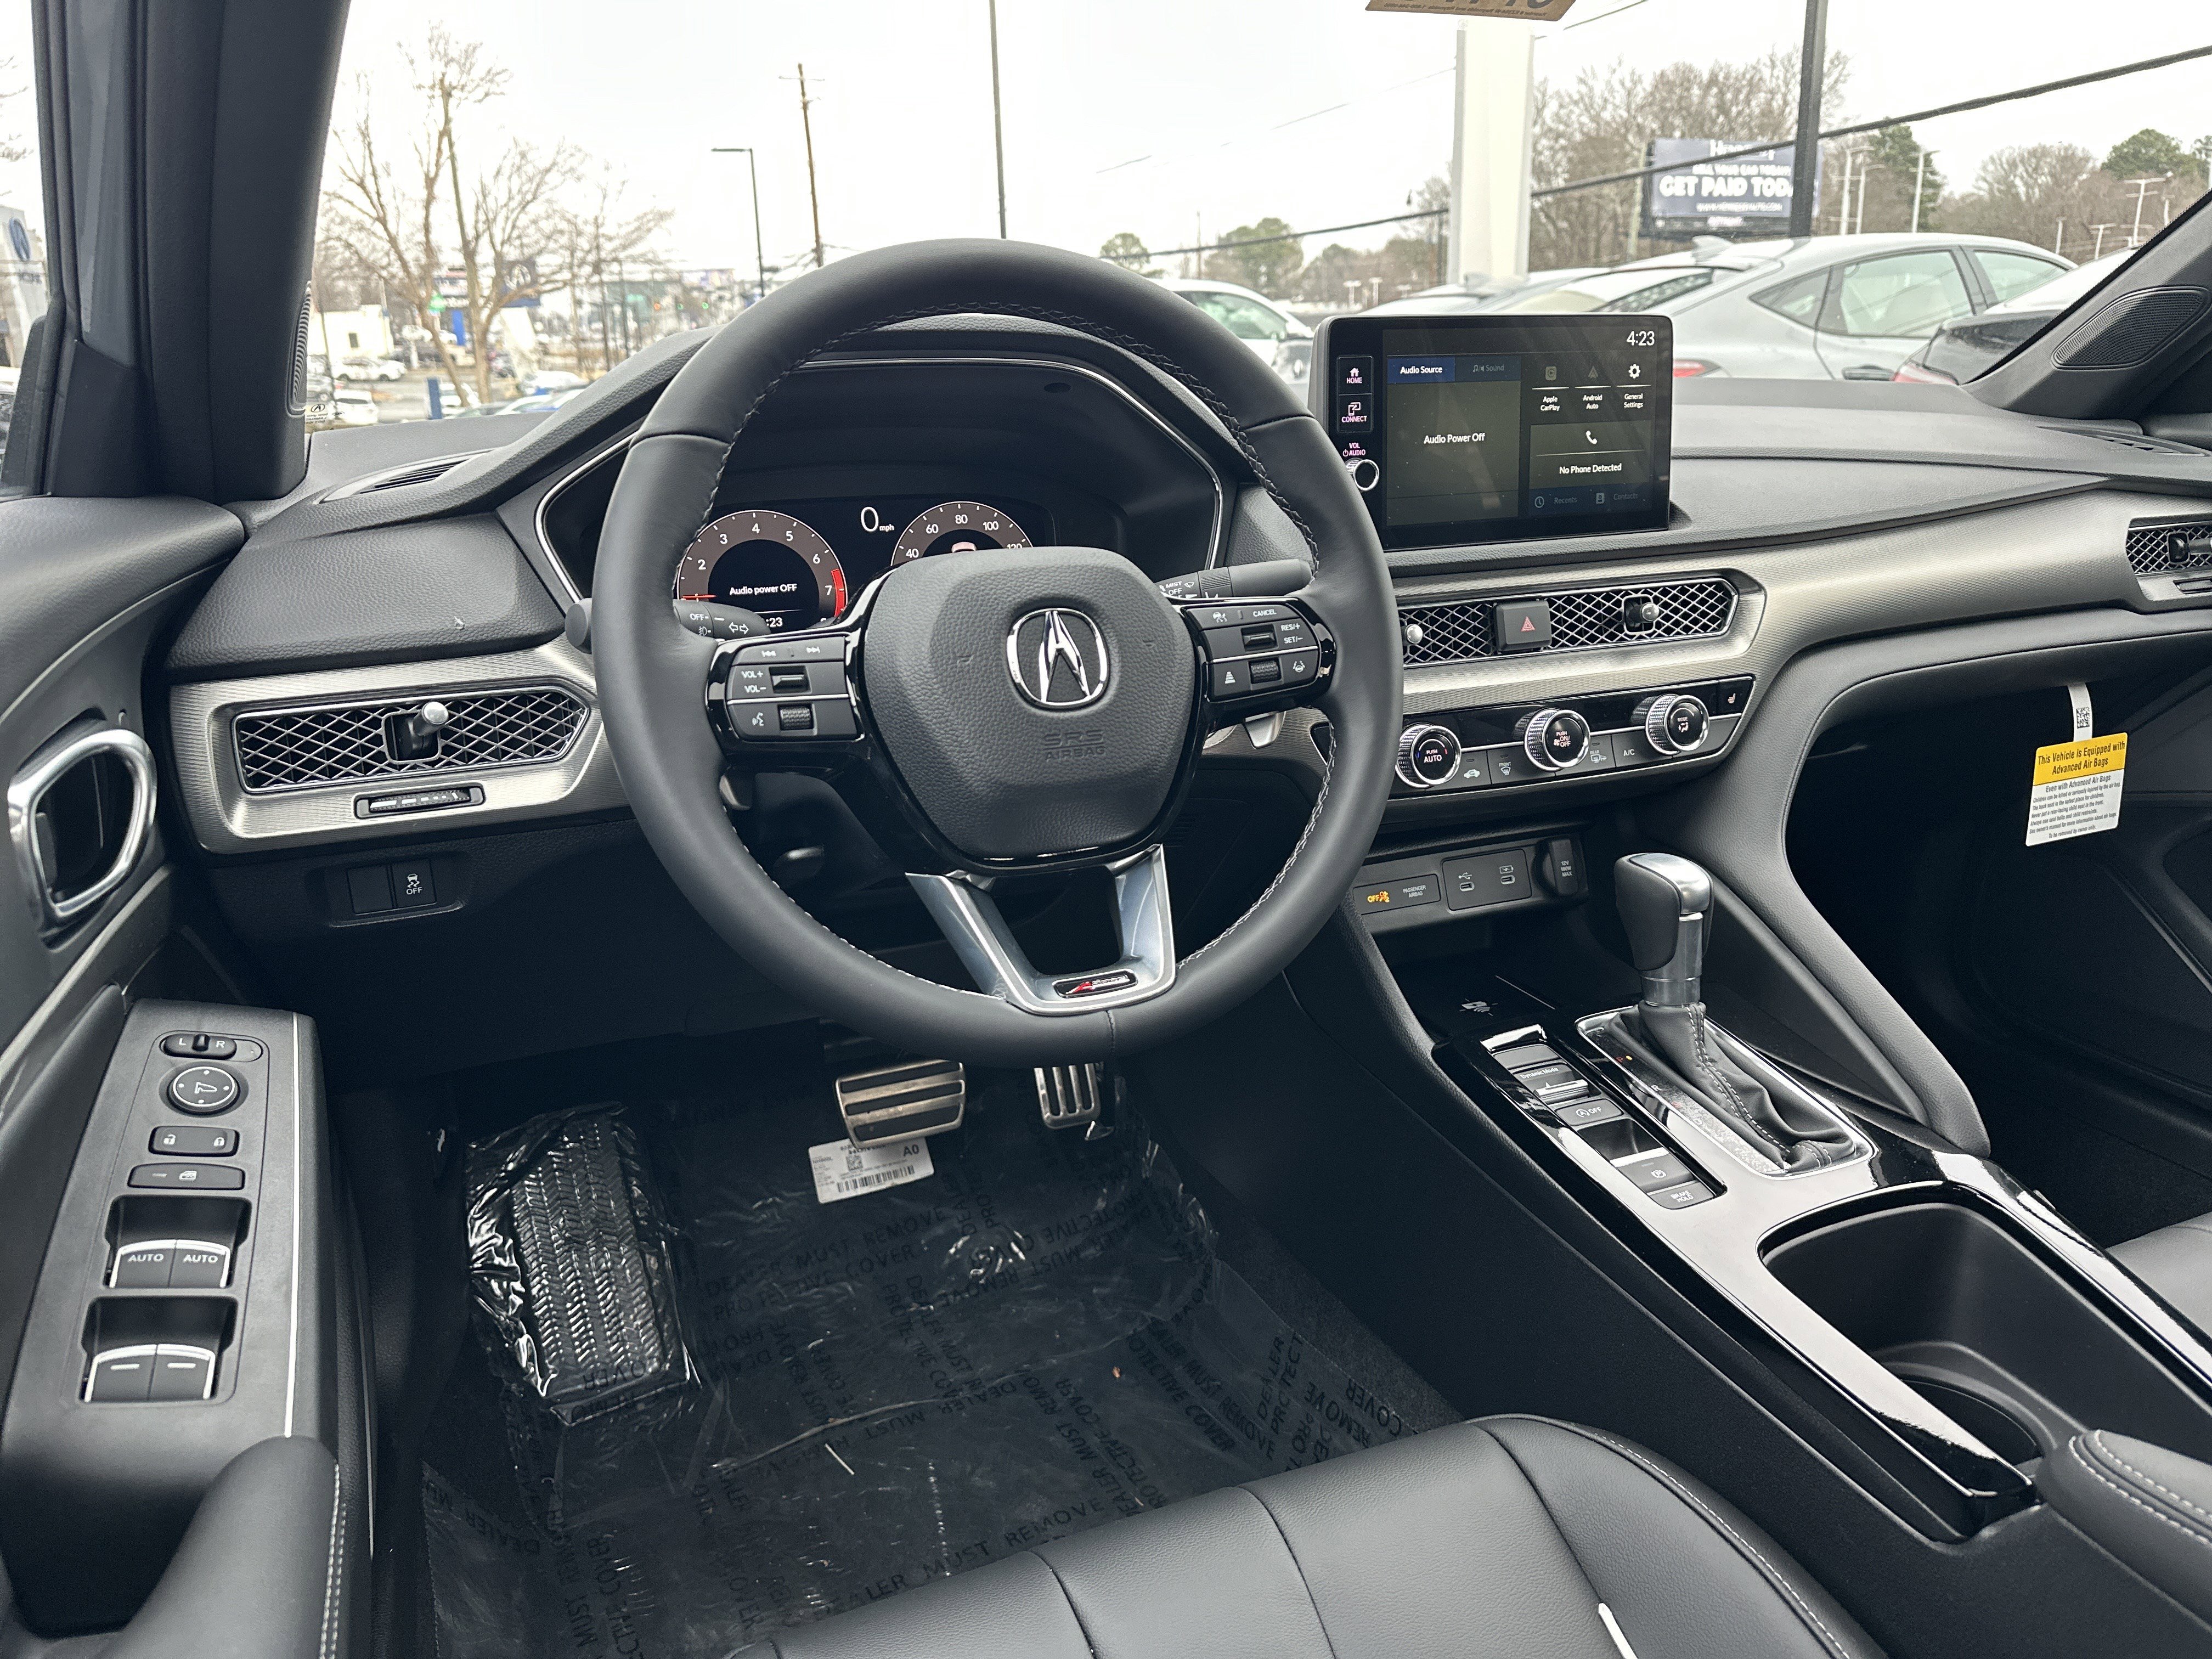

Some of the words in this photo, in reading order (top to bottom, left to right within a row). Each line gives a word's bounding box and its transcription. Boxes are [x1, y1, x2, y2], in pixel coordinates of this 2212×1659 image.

[1660, 175, 1699, 196] GET
[1701, 177, 1748, 197] PAID
[1626, 331, 1655, 346] 4:23
[1400, 366, 1418, 374] Audio
[1419, 365, 1443, 374] Source
[1486, 363, 1504, 373] Sound
[1543, 396, 1558, 404] Apple
[1540, 403, 1560, 412] CarPlay
[1623, 402, 1644, 410] Settings
[1341, 415, 1368, 423] CONNECT
[1424, 434, 1445, 444] Audio
[1447, 433, 1470, 444] Power
[1472, 432, 1485, 442] Off
[1559, 465, 1568, 473] No
[1570, 465, 1590, 473] Phone
[1592, 462, 1622, 472] Detected
[1554, 496, 1577, 505] Recents
[955, 514, 968, 524] 80
[752, 523, 760, 534] 4
[879, 523, 894, 533] mph
[926, 524, 939, 534] 60
[983, 521, 999, 531] 100
[719, 533, 728, 544] 3
[786, 531, 793, 541] 5
[906, 548, 919, 558] 40
[697, 559, 707, 570] 2
[812, 554, 821, 565] 6
[729, 585, 753, 595] Audio
[754, 585, 778, 595] power
[780, 583, 797, 592] OFF
[825, 585, 832, 596] 7
[1253, 609, 1277, 617] CANCEL
[765, 617, 783, 628] :23
[2038, 755, 2050, 765] This
[2052, 750, 2075, 761] Vehicle
[2084, 743, 2111, 757] Equipped
[2113, 741, 2125, 751] with
[1424, 754, 1442, 763] AUTO
[2052, 762, 2081, 775] Advanced
[2083, 758, 2092, 769] Air
[2094, 757, 2108, 769] Bags
[2069, 778, 2091, 788] Advanced
[1403, 884, 1426, 894] PASSENGER
[1367, 894, 1380, 903] OFF
[1520, 1068, 1542, 1079] Dynamic
[1543, 1066, 1559, 1075] Mode
[1588, 1106, 1602, 1115] OFF
[903, 1144, 919, 1156] A0
[1671, 1190, 1690, 1200] BRAKE
[1676, 1194, 1694, 1203] HOLD
[128, 1254, 163, 1262] AUTO
[183, 1254, 218, 1263] AUTO
